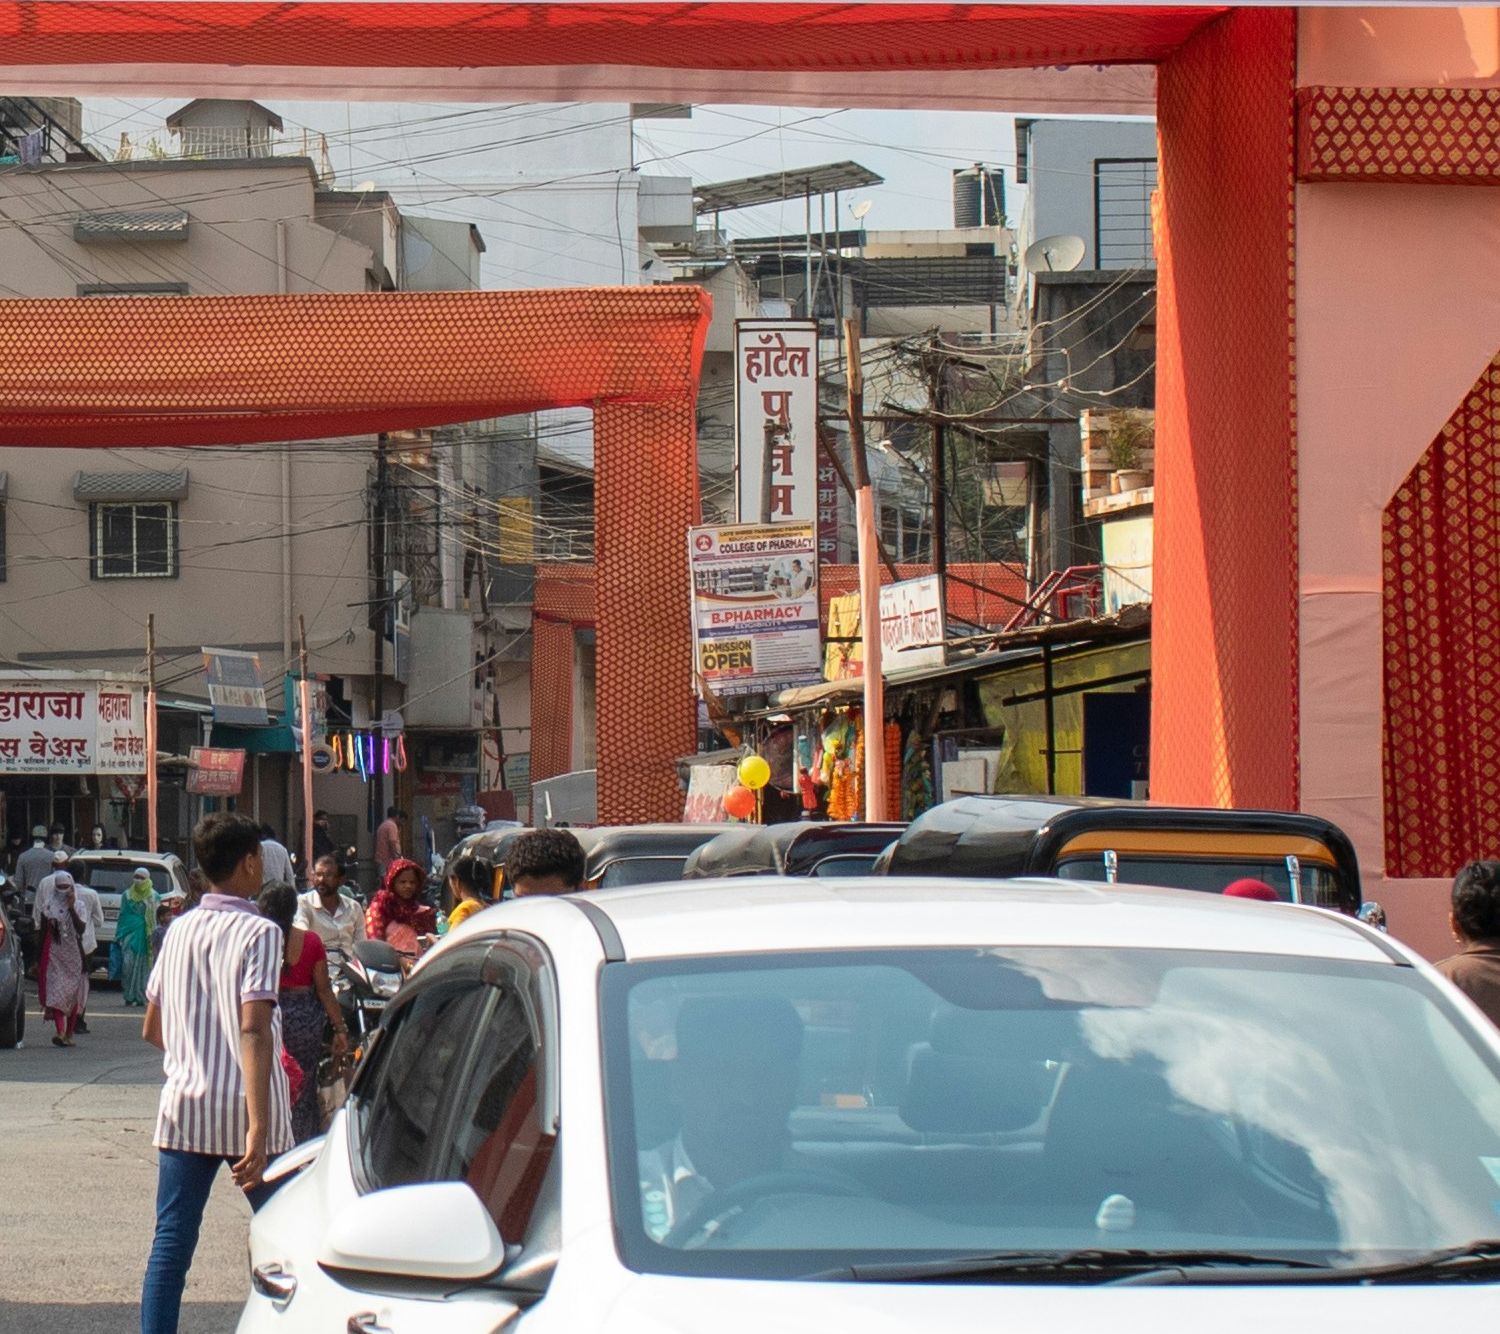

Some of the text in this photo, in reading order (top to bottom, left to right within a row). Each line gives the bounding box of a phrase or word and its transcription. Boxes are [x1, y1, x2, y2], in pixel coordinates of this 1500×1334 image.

[744, 333, 810, 383] हॉटेल
[720, 538, 813, 554] COLLEGE OF PHARMACY
[712, 606, 802, 624] B.PHARMACY
[702, 640, 751, 653] ADMISSION
[704, 652, 752, 670] OPEN
[29, 731, 87, 758] वेअर
